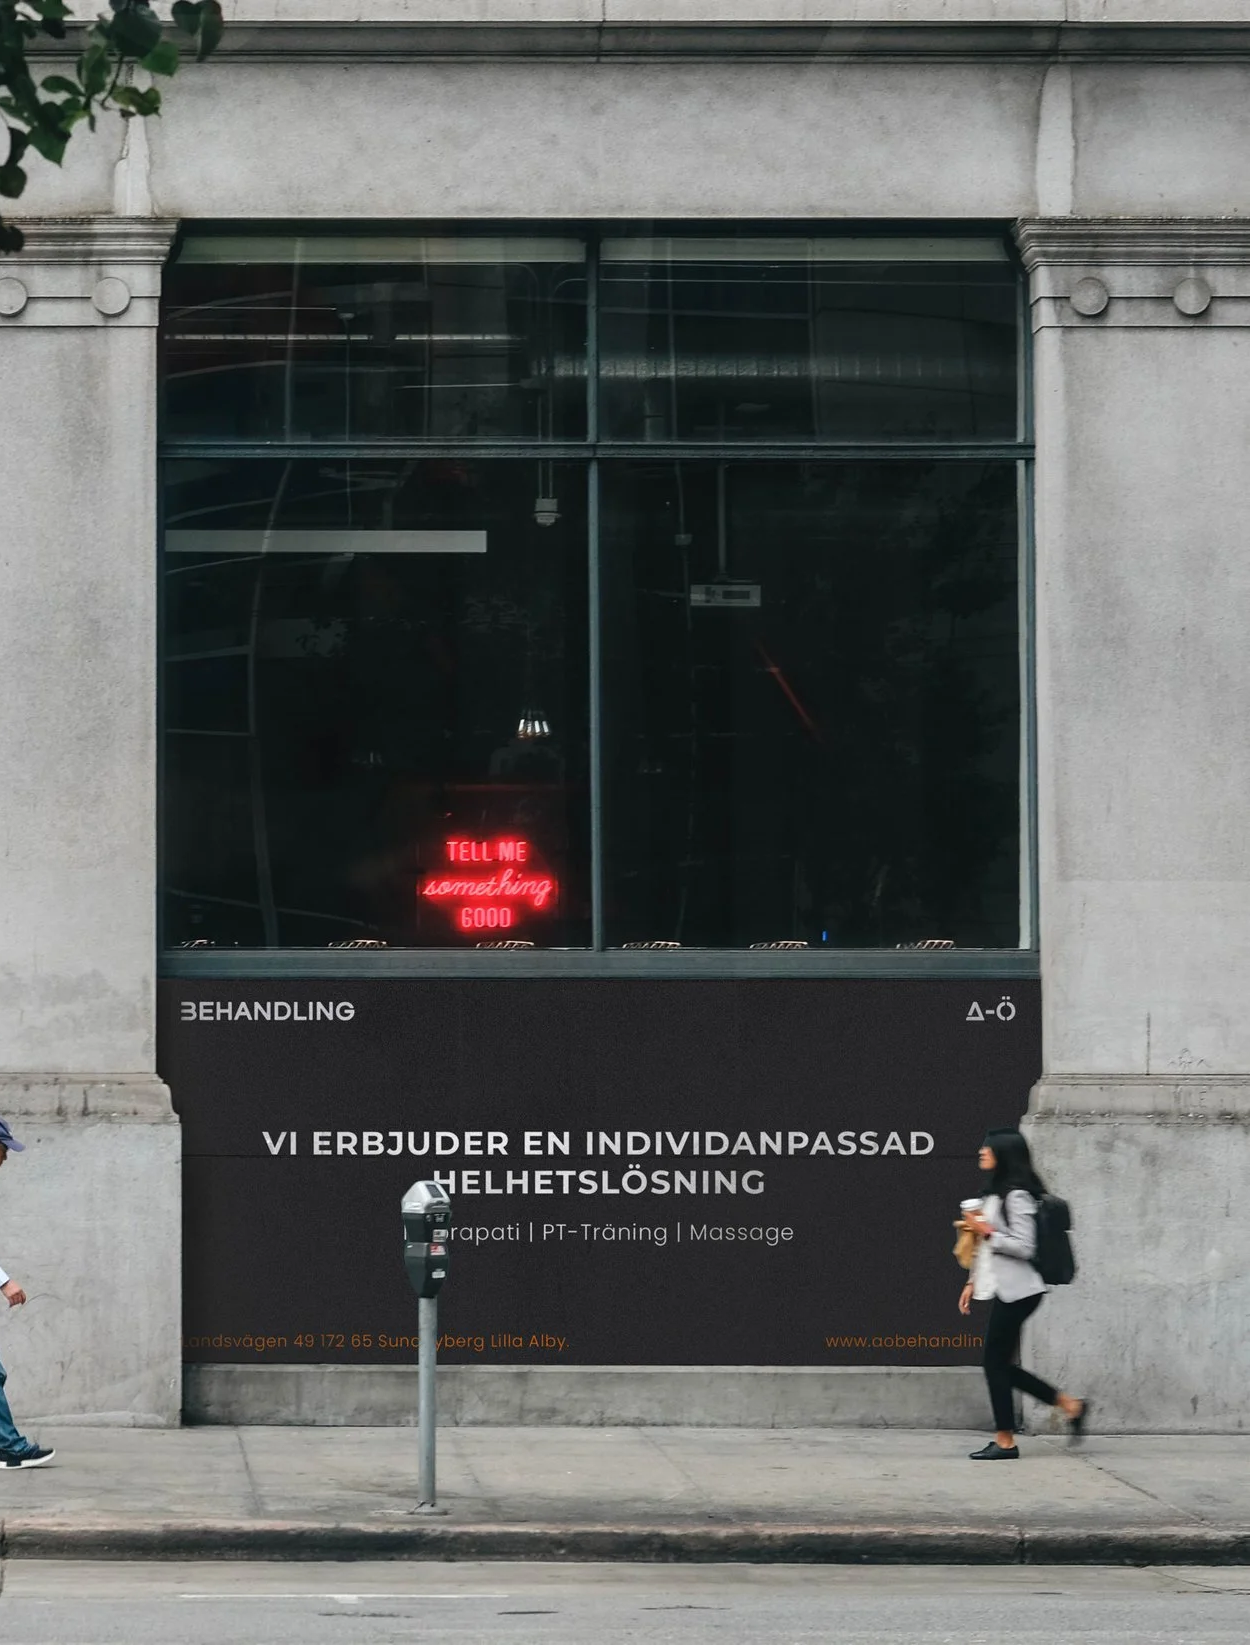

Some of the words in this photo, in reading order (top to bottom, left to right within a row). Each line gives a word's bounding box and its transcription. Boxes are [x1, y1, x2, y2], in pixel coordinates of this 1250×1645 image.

[446, 841, 493, 862] TELL
[498, 841, 527, 862] ME
[422, 868, 553, 906] something
[461, 907, 512, 928] GOOD
[180, 1001, 356, 1022] BEHANDLING
[261, 1131, 297, 1156] VI
[313, 1131, 509, 1156] ERBJUDER
[523, 1131, 570, 1156] EN
[586, 1130, 935, 1156] INDIVIDANPASSAD
[433, 1163, 765, 1195] HELHETSLÖSNING
[543, 1222, 667, 1247] PT-Träning
[690, 1224, 794, 1247] Massage
[294, 1333, 314, 1348] 49
[320, 1333, 345, 1348] 172
[351, 1333, 372, 1348] 65
[378, 1333, 485, 1352] Sunyberg
[491, 1333, 523, 1348] Lilla
[529, 1333, 570, 1351] Alby.
[825, 1333, 986, 1349] www.aobehandlin
